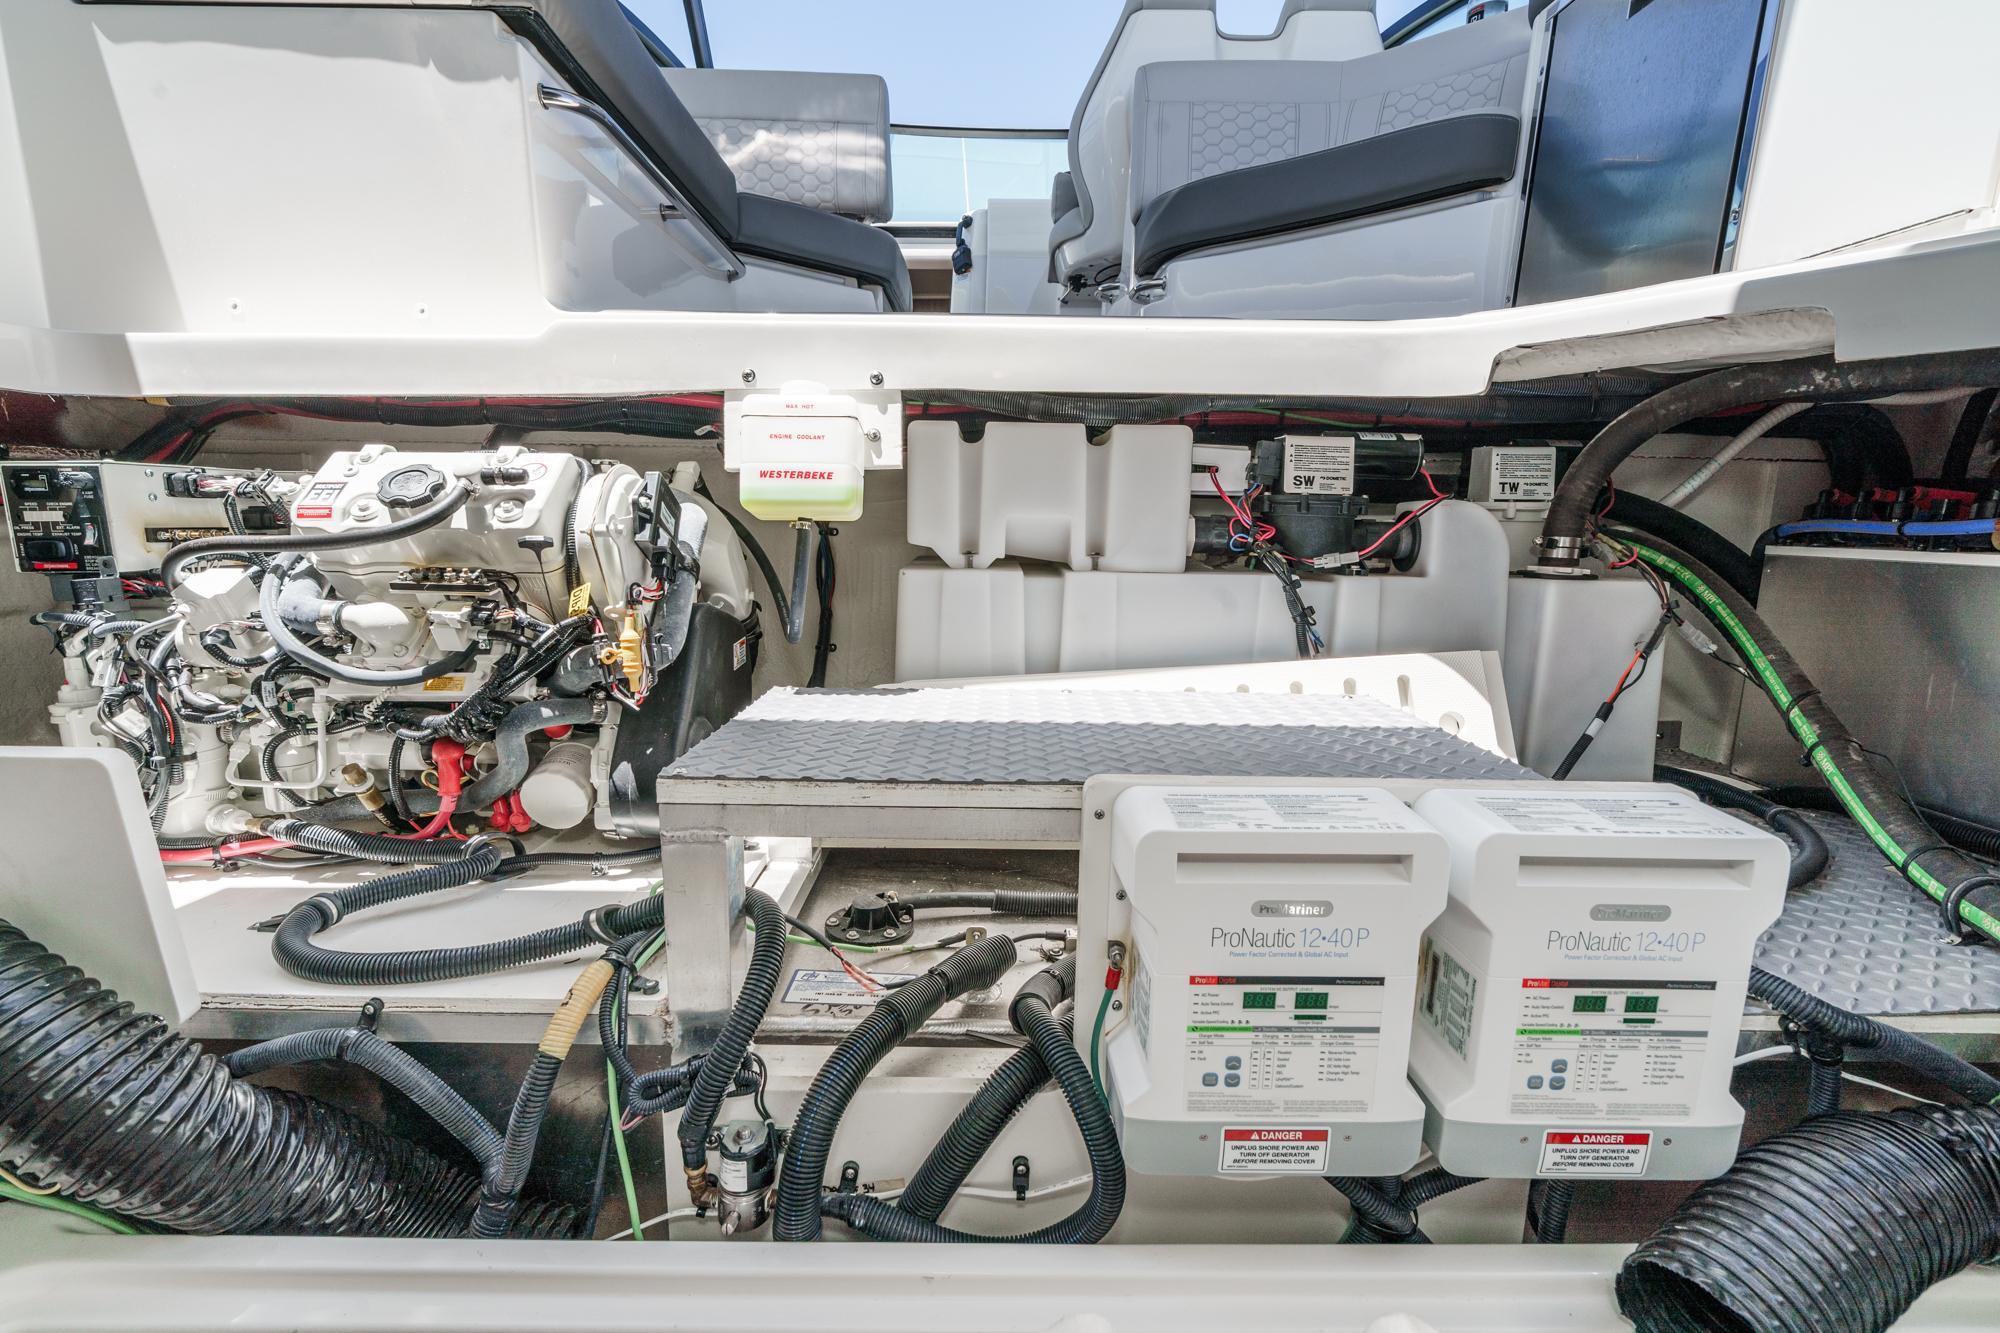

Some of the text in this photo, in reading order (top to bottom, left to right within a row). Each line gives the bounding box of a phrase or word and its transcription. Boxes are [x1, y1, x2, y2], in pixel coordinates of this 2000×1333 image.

[760, 470, 833, 479] WESTERBEKE
[1293, 475, 1315, 486] SW
[1499, 482, 1519, 492] TW
[1212, 927, 1296, 948] ProNautic
[1547, 930, 1631, 951] ProNautic
[1583, 1135, 1624, 1143] DANGER
